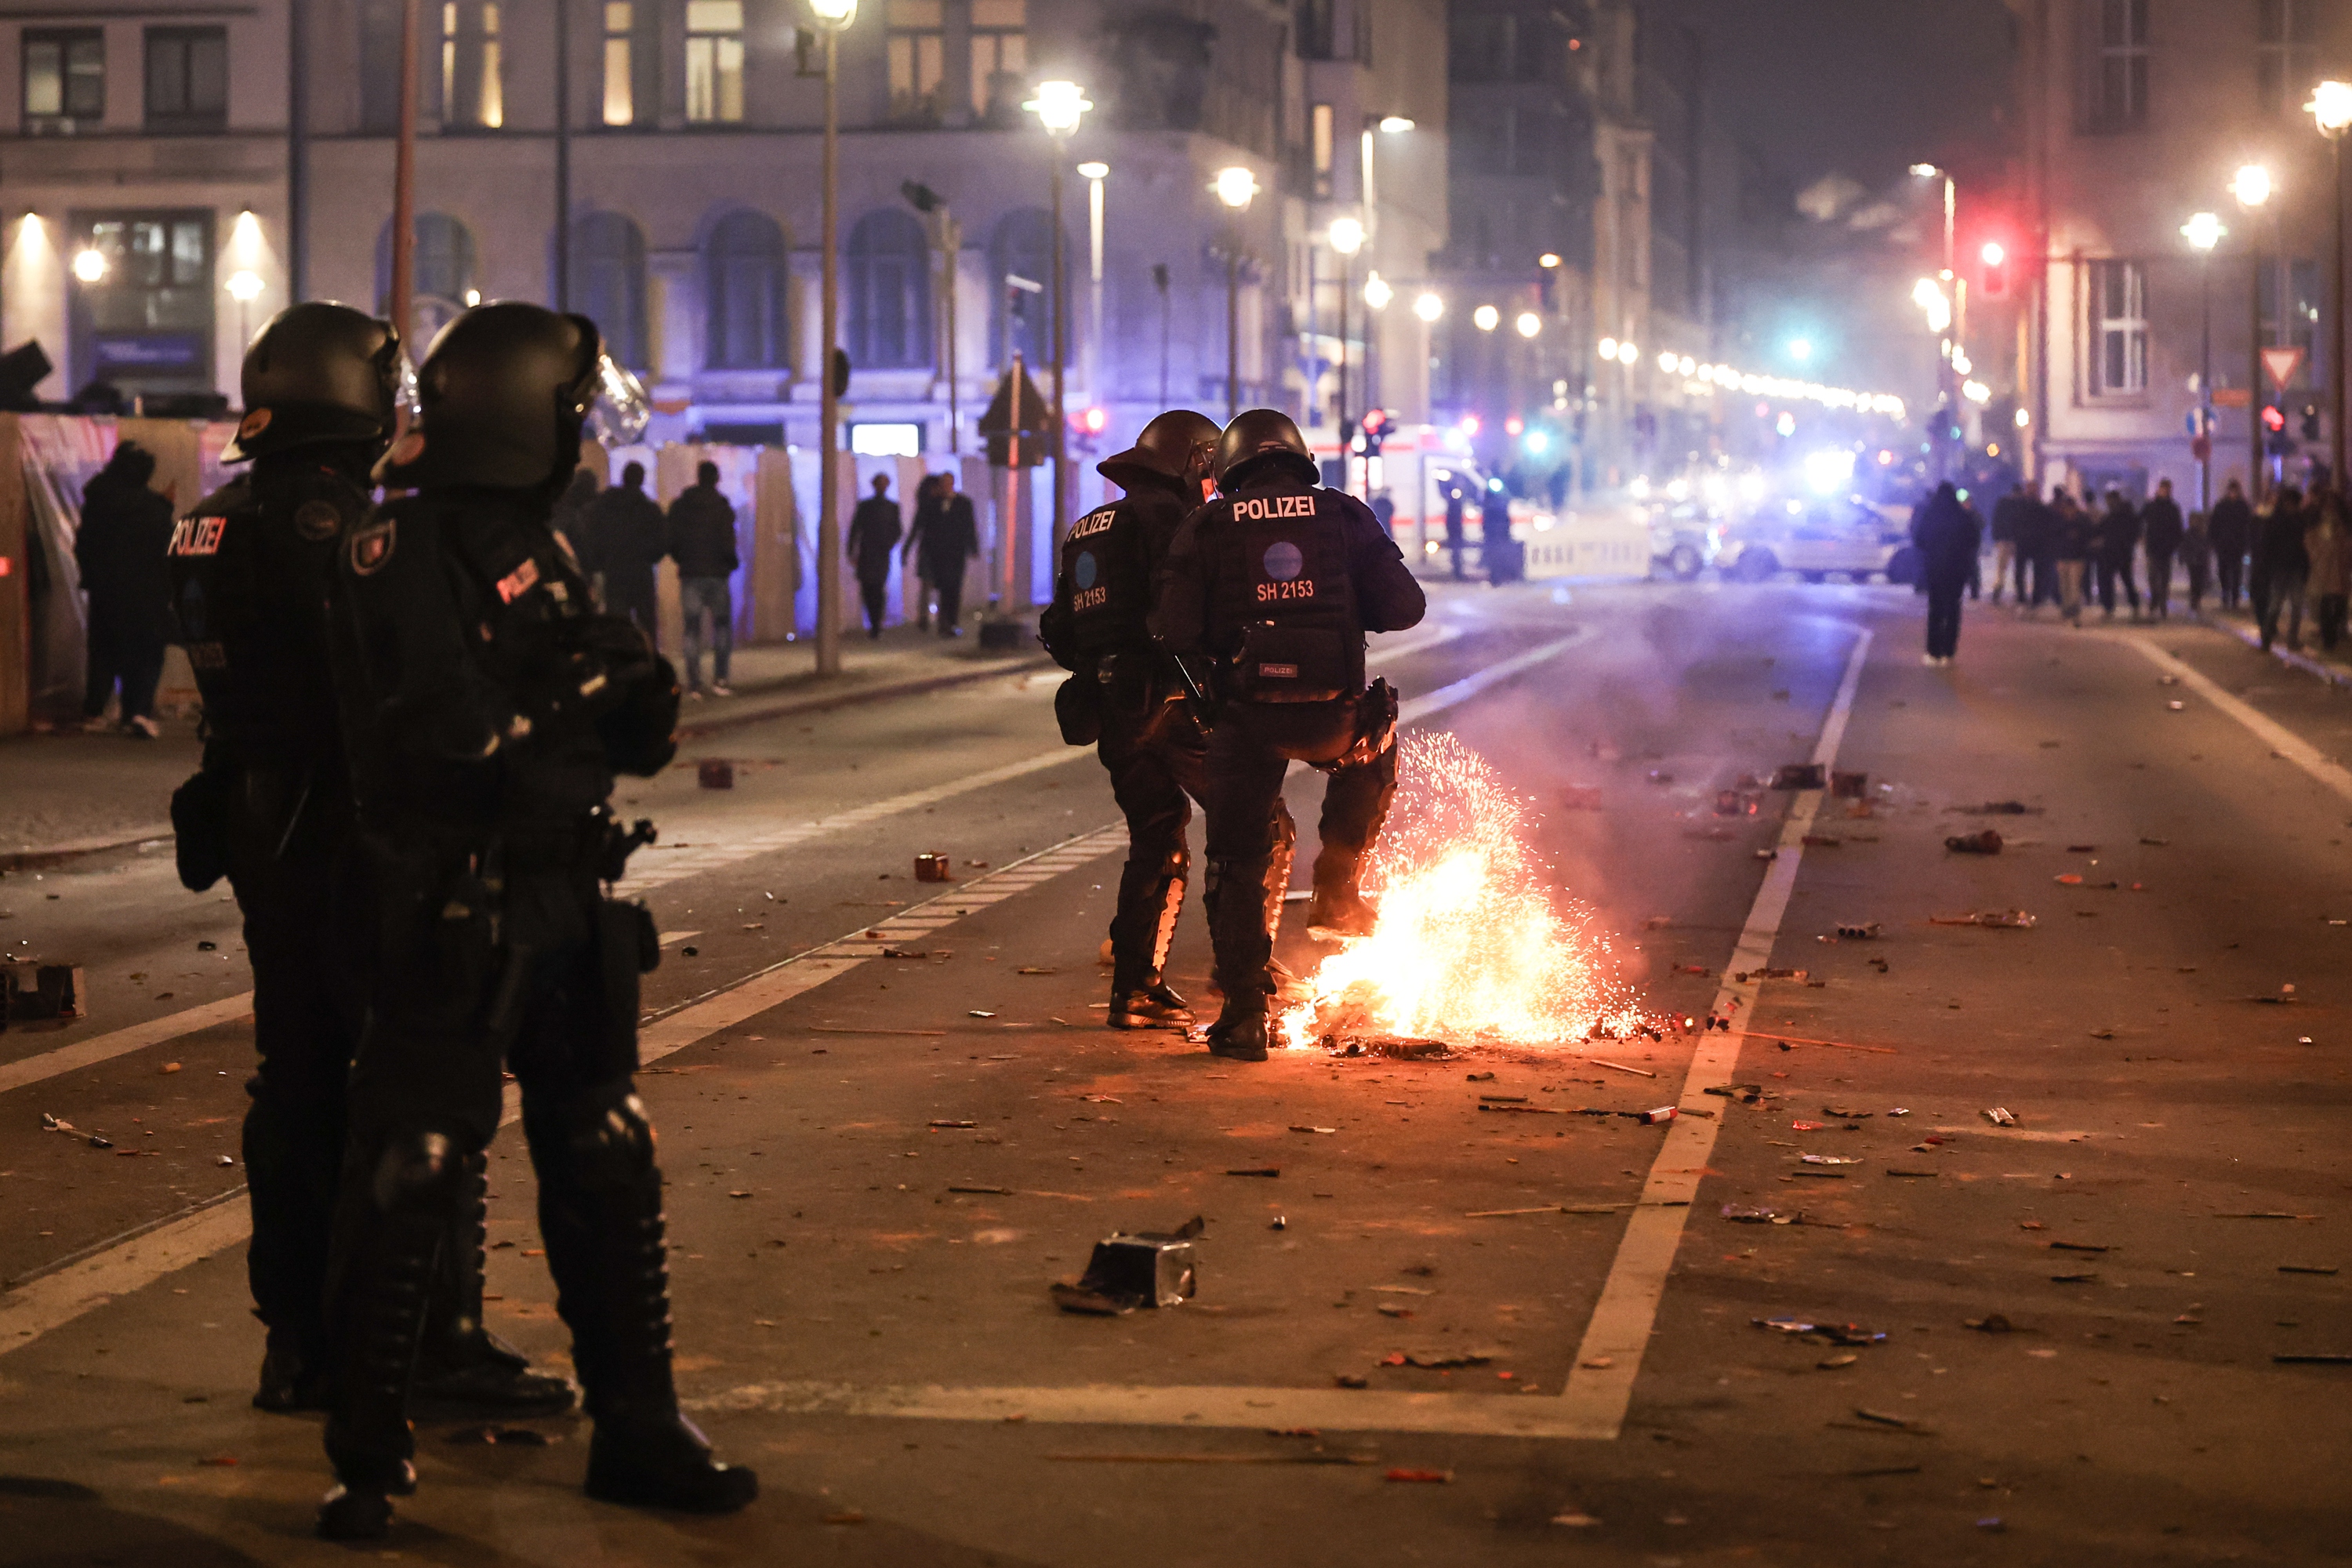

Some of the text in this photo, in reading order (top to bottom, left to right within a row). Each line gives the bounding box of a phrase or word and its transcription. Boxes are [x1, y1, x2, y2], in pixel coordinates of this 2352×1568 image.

[1232, 495, 1316, 522] POLIZEI
[167, 516, 227, 556] POLIZEI
[1067, 510, 1116, 542] POLIZEI
[1073, 586, 1106, 612] SH 2153
[1257, 579, 1314, 601] SH 2153
